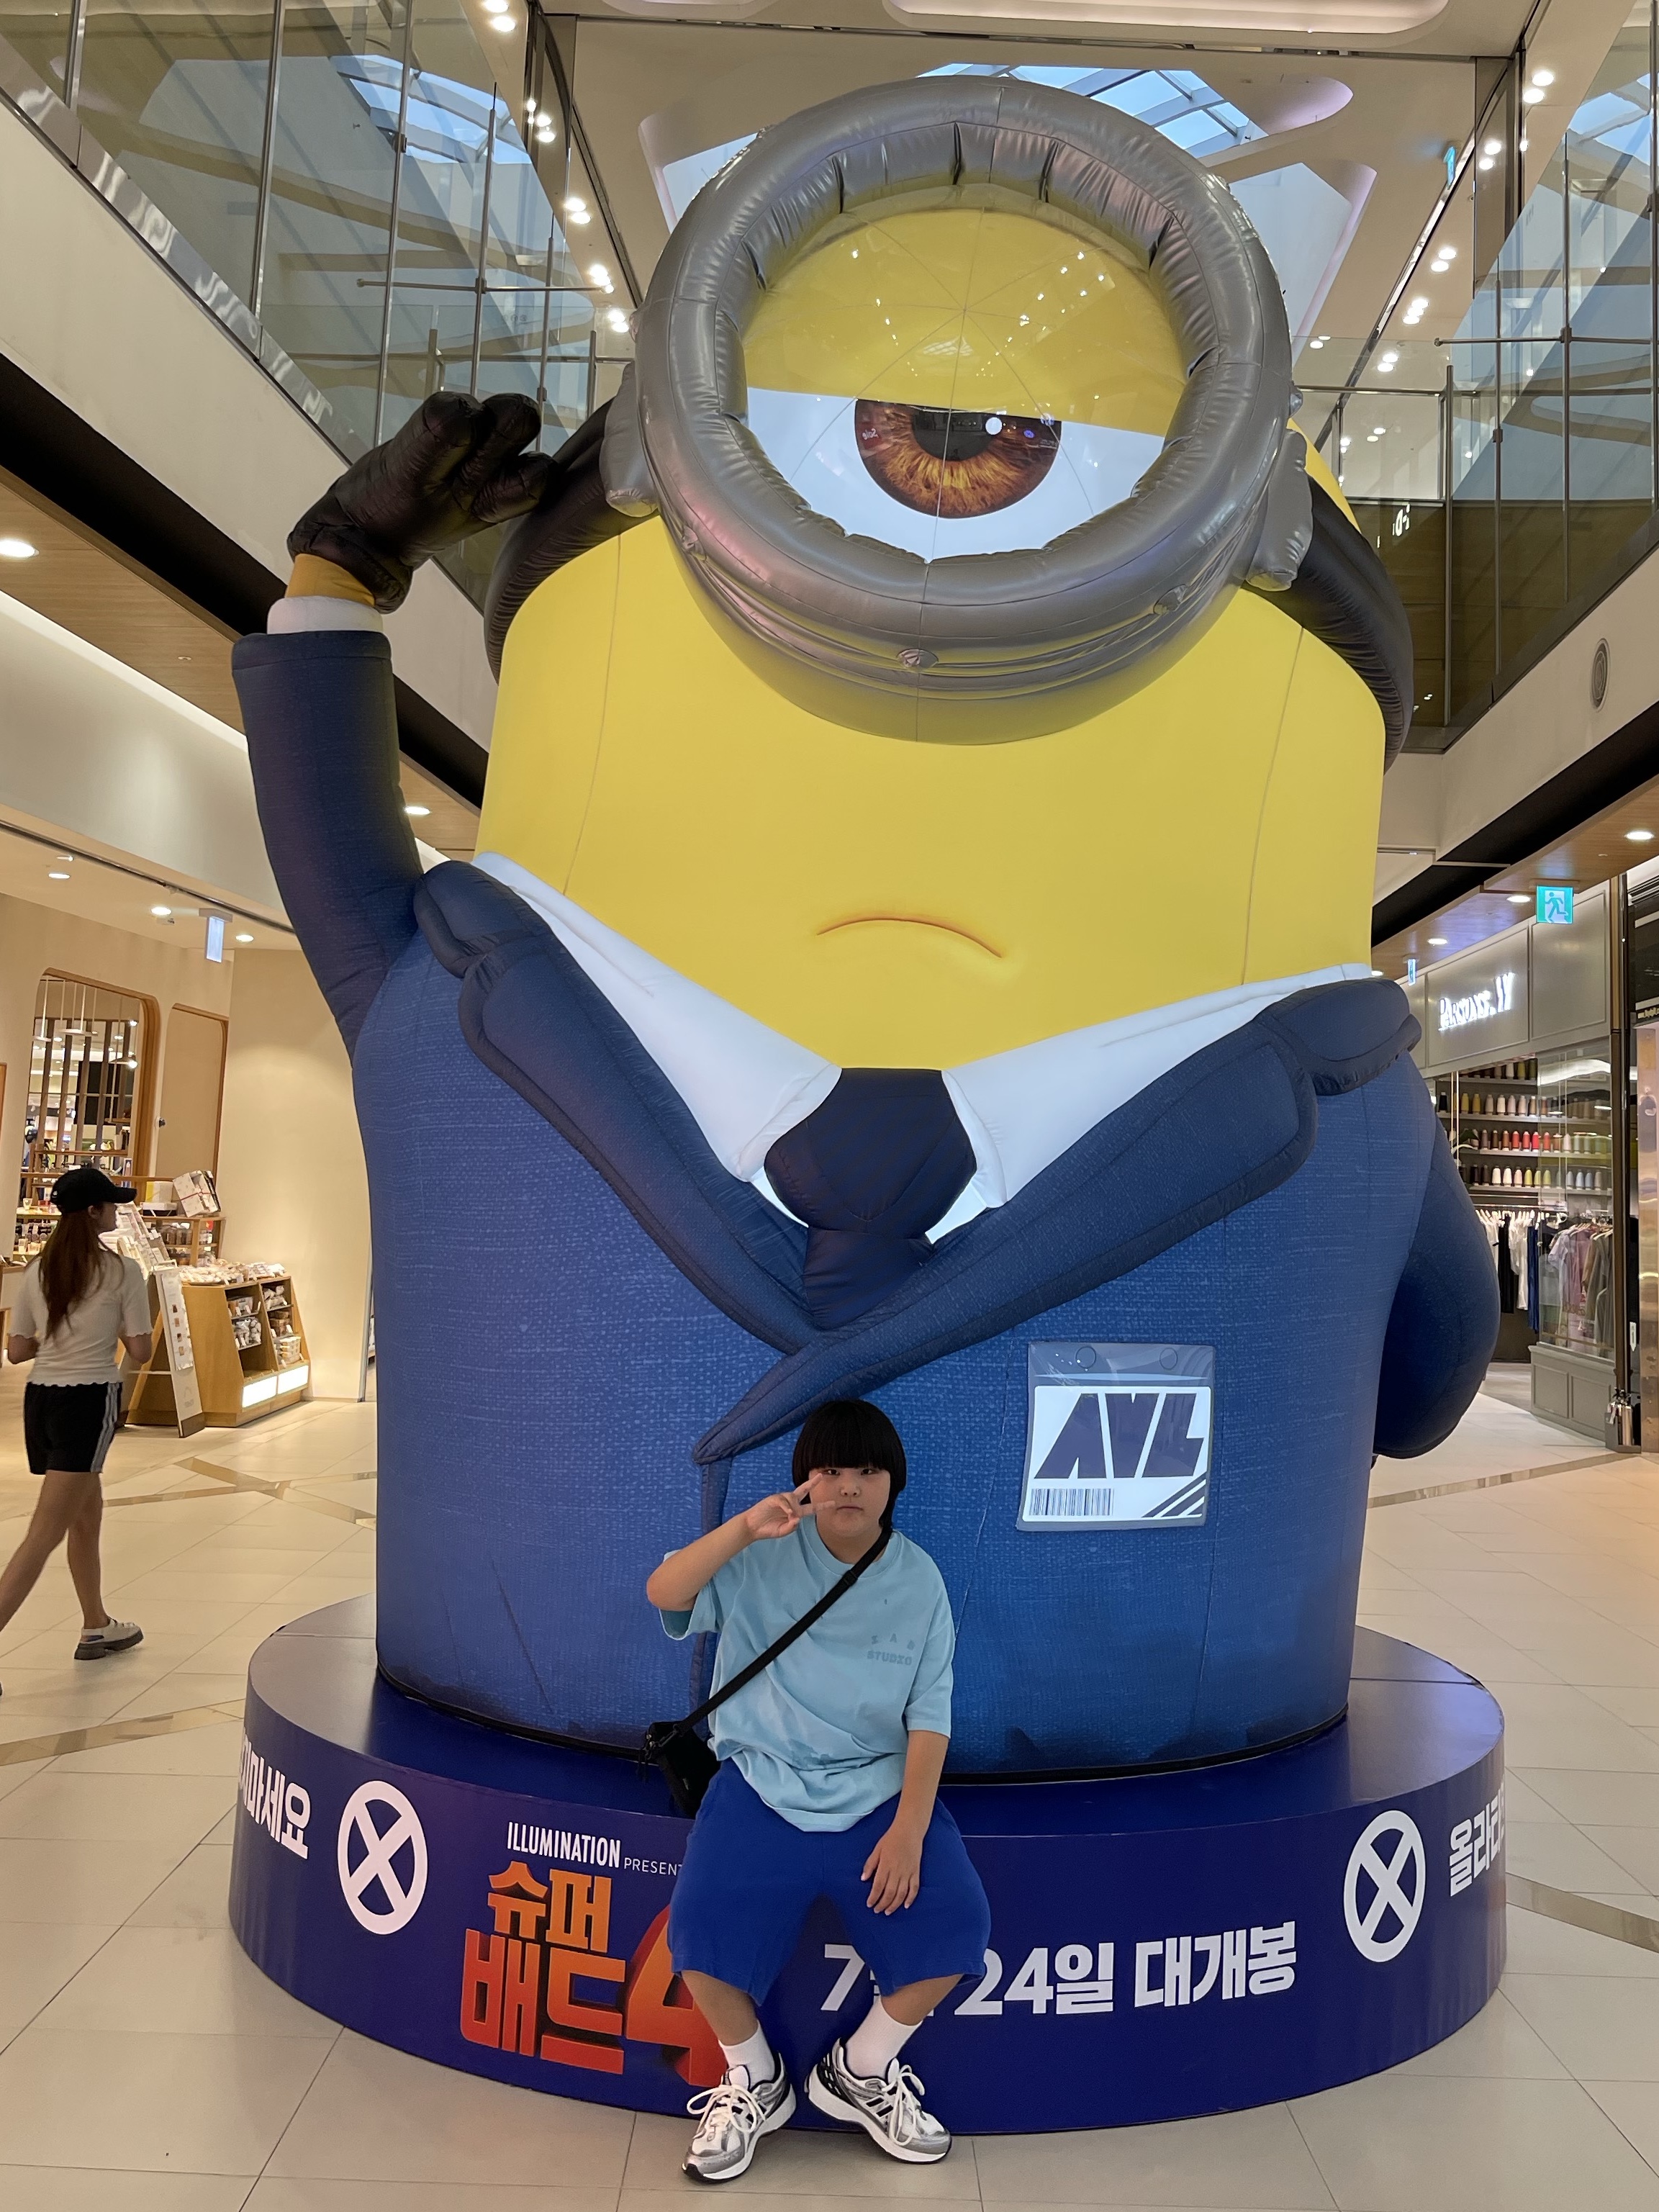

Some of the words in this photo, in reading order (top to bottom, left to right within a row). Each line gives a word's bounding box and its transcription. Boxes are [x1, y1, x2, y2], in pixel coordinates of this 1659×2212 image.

[867, 1651, 913, 1666] STUDIO
[507, 1821, 621, 1868] ILLUMINATION
[487, 1860, 612, 1954] 슈퍼
[461, 1928, 626, 2075] 배드
[954, 1942, 1114, 2015] 24일
[1134, 1920, 1297, 2008] 대개봉
